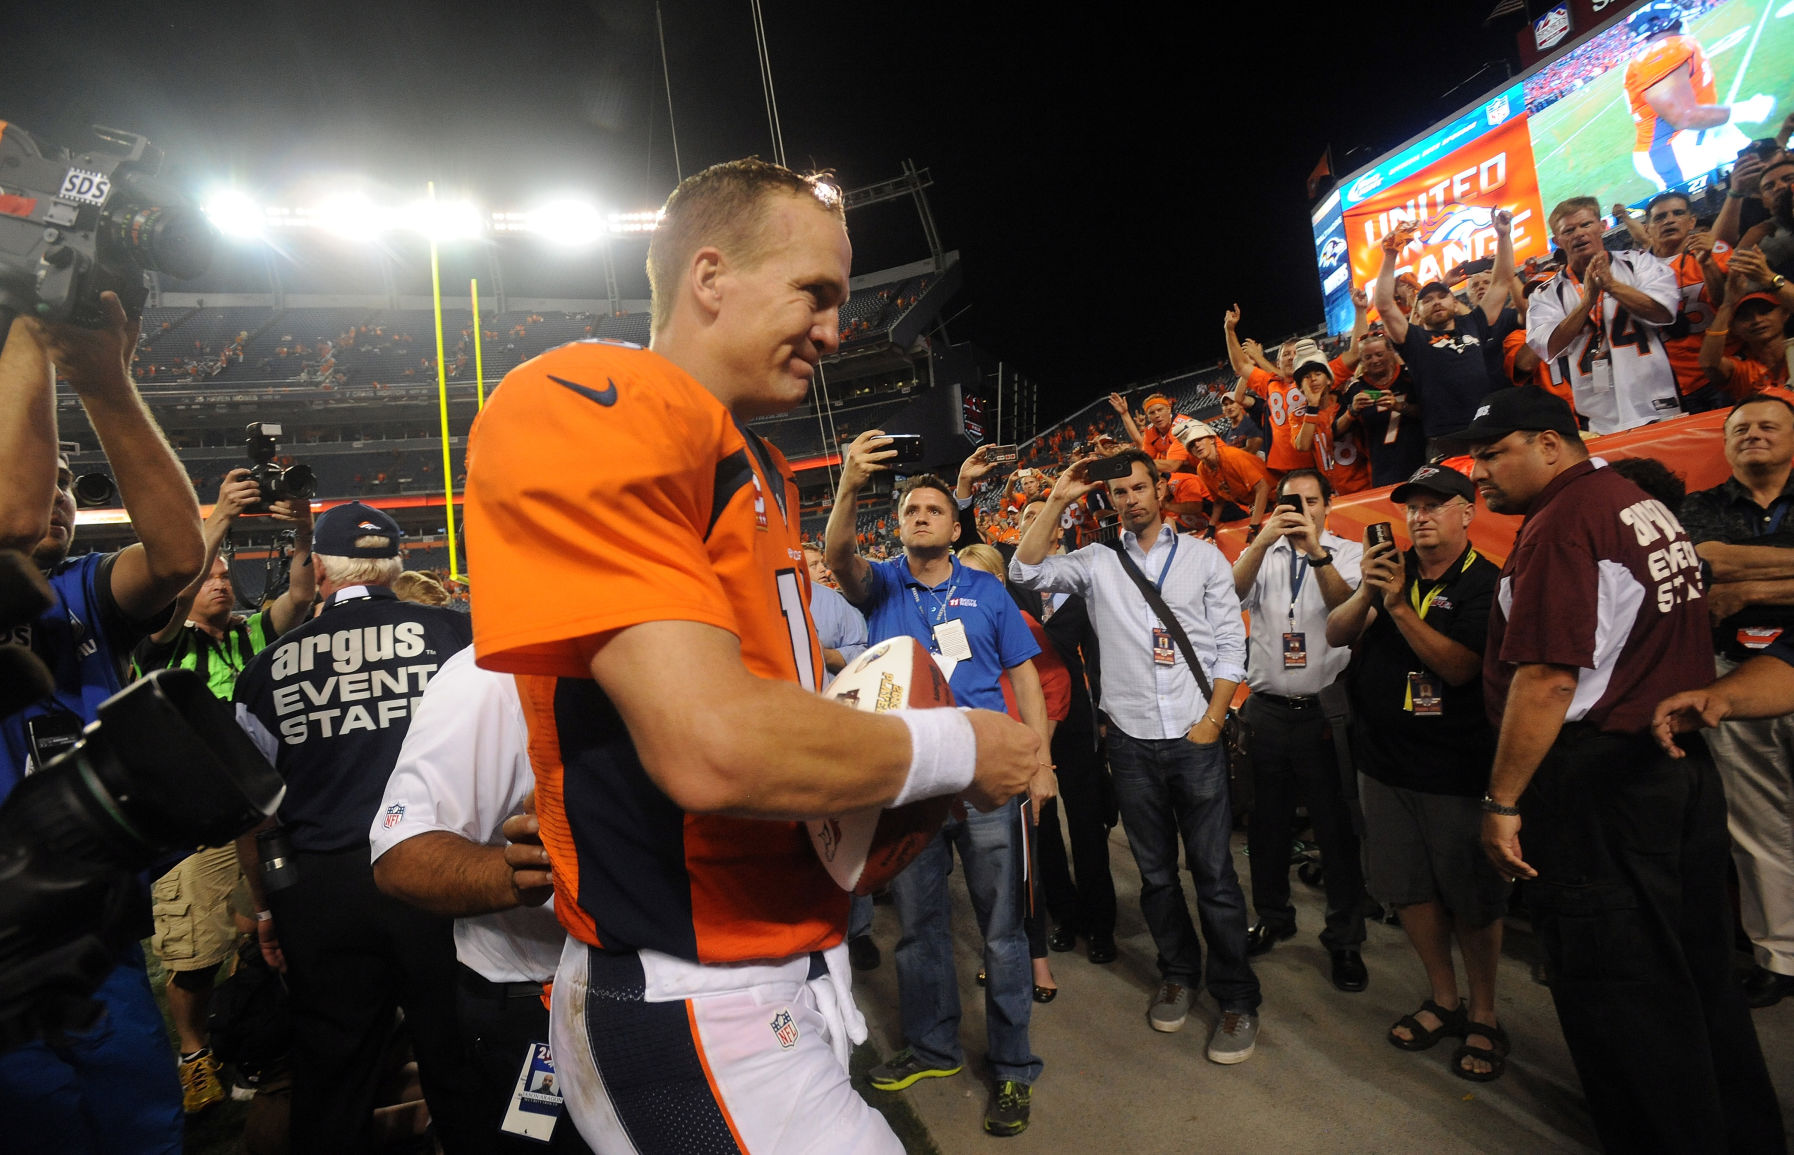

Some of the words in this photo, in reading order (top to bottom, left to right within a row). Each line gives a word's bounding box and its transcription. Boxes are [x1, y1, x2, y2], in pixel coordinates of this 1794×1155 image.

[64, 174, 108, 199] SDS
[1364, 151, 1507, 249] UNITED
[271, 621, 425, 681] argus
[273, 664, 438, 717] EVENT
[778, 1023, 797, 1045] NFL
